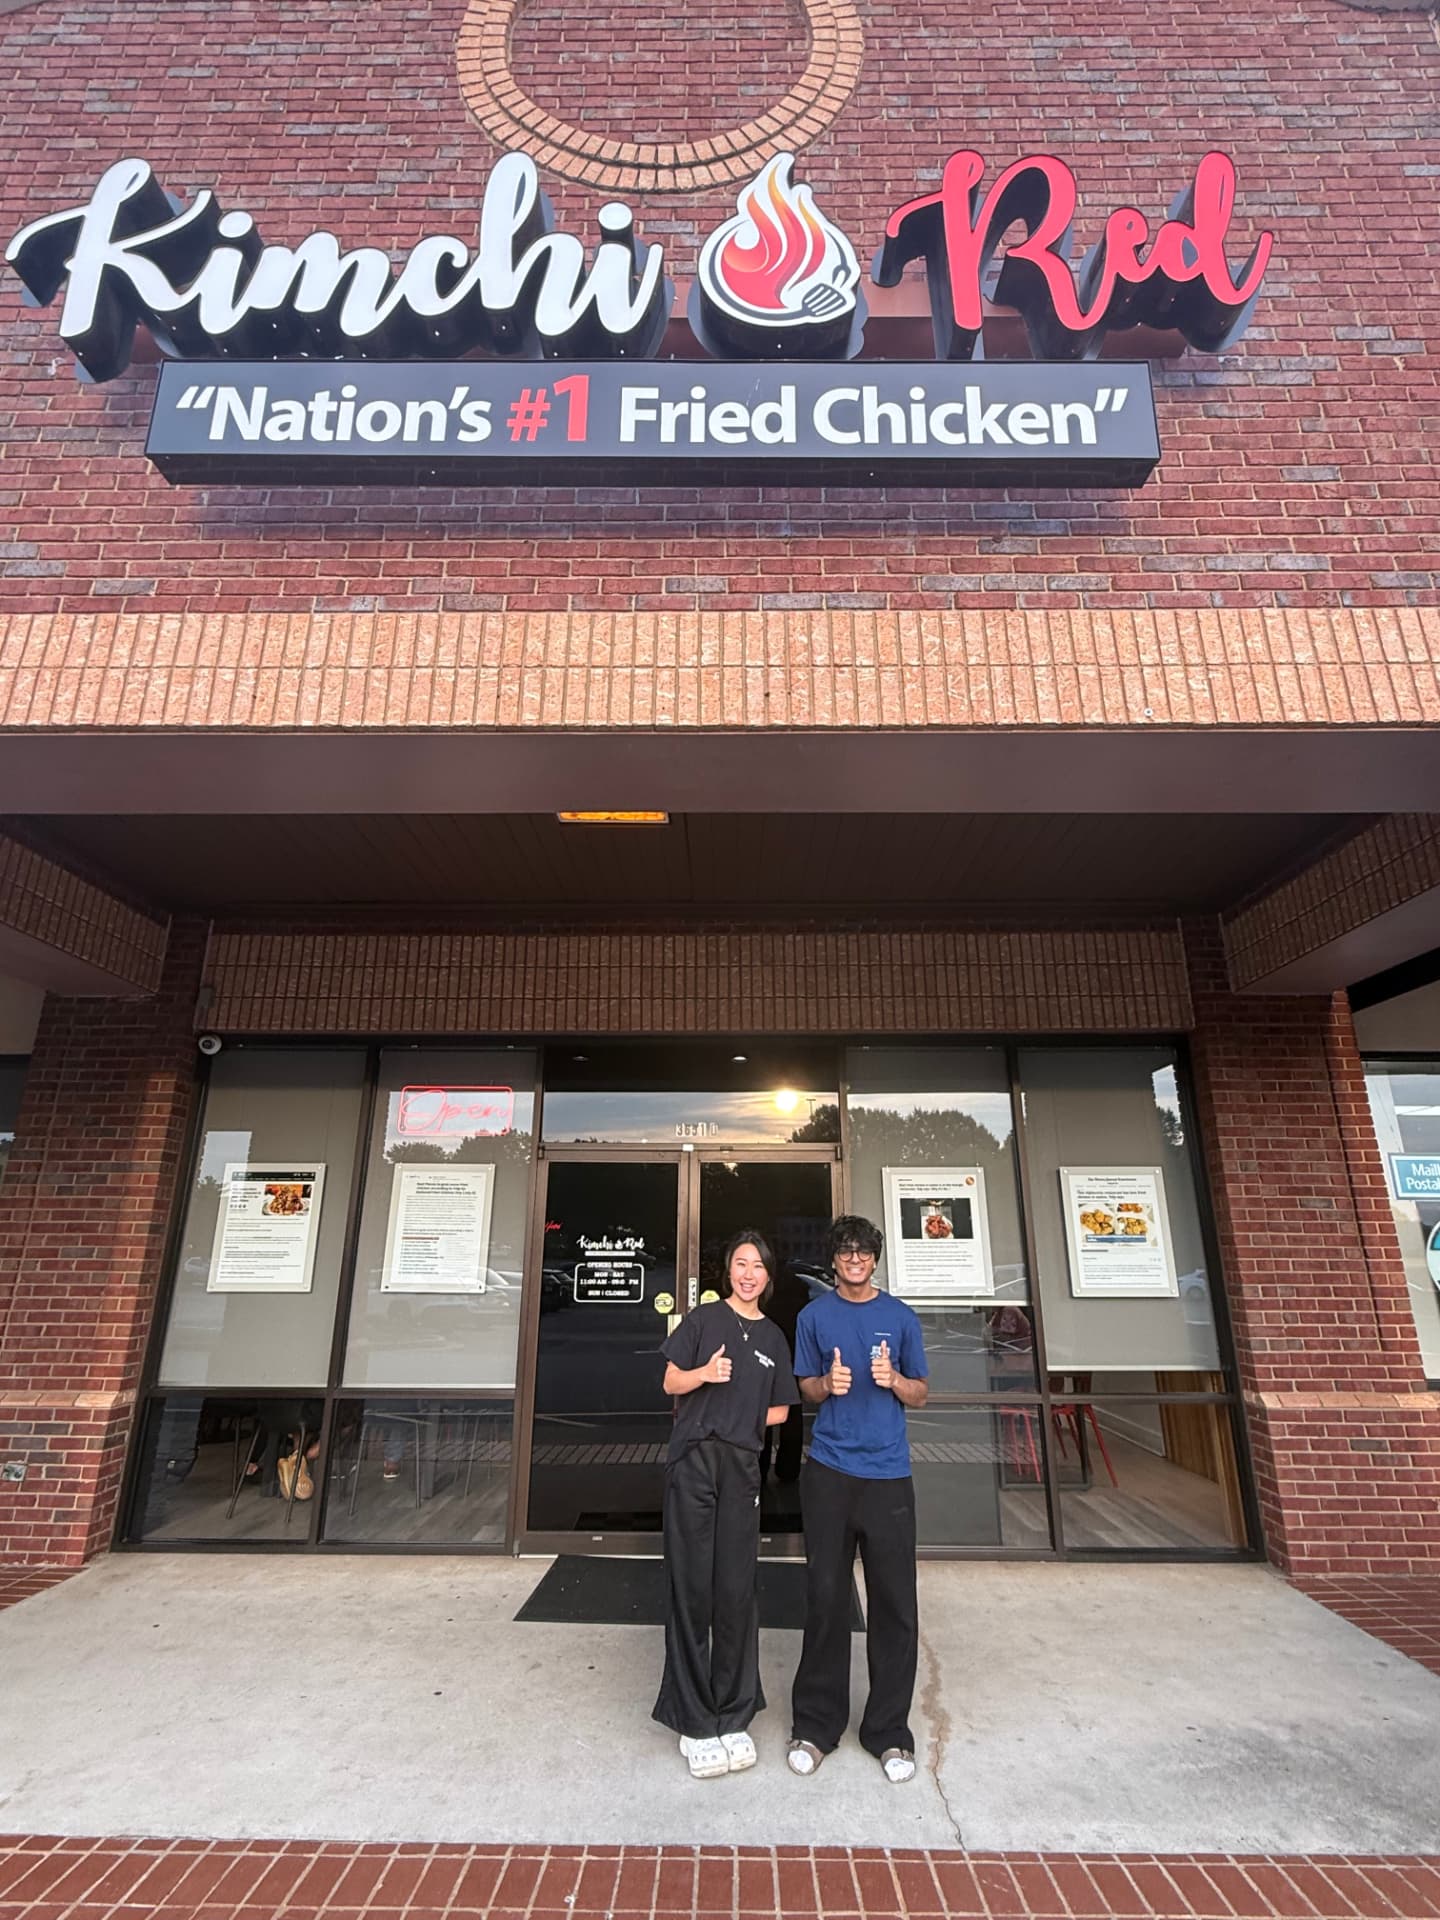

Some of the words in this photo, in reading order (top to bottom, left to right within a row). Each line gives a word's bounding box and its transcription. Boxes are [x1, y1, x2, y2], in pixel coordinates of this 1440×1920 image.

[5, 151, 663, 337] Kimchi
[886, 150, 1273, 331] Red
[175, 384, 492, 443] "Nation's
[506, 374, 590, 442] #1
[619, 384, 796, 444] Fried
[813, 384, 1128, 444] Chicken"
[402, 1089, 508, 1132] Open
[576, 1235, 613, 1250] Kimchi
